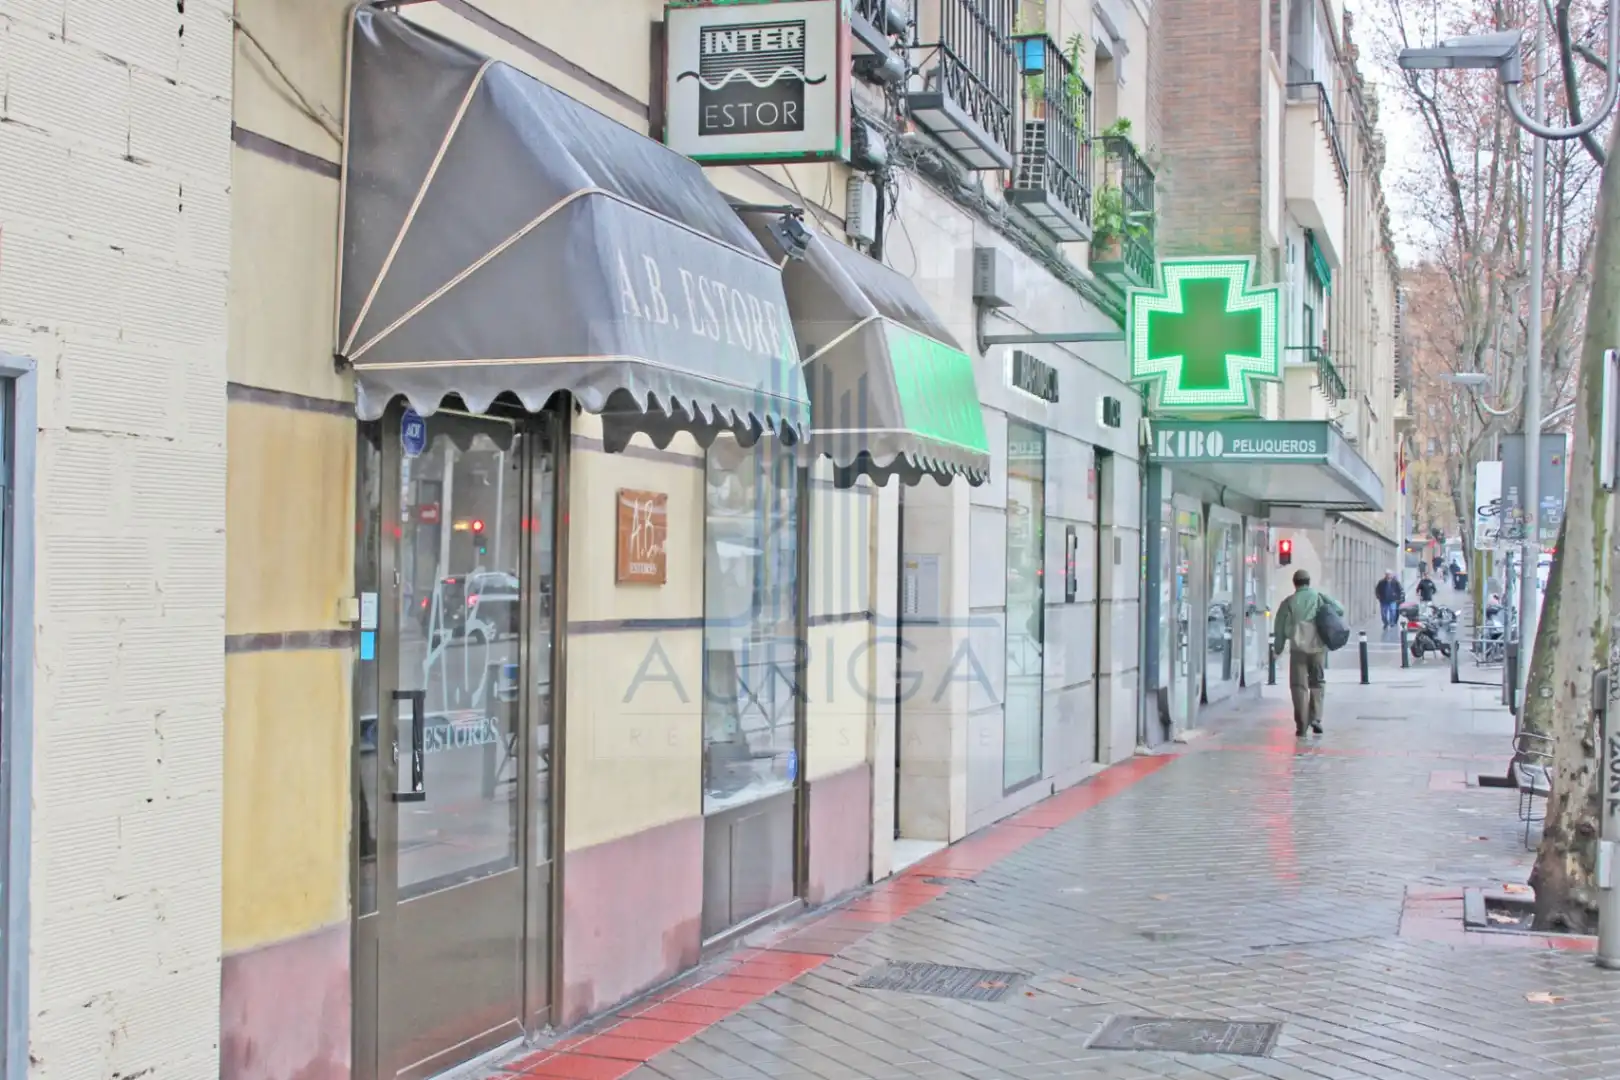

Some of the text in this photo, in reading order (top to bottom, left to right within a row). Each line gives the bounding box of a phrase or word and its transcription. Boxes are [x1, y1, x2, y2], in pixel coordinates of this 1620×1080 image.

[703, 27, 802, 53] INTER
[704, 100, 798, 129] ESTOR
[616, 249, 680, 331] A.B.
[1157, 430, 1317, 458] KIBO PELUQUEROS
[423, 716, 500, 754] ESTORES
